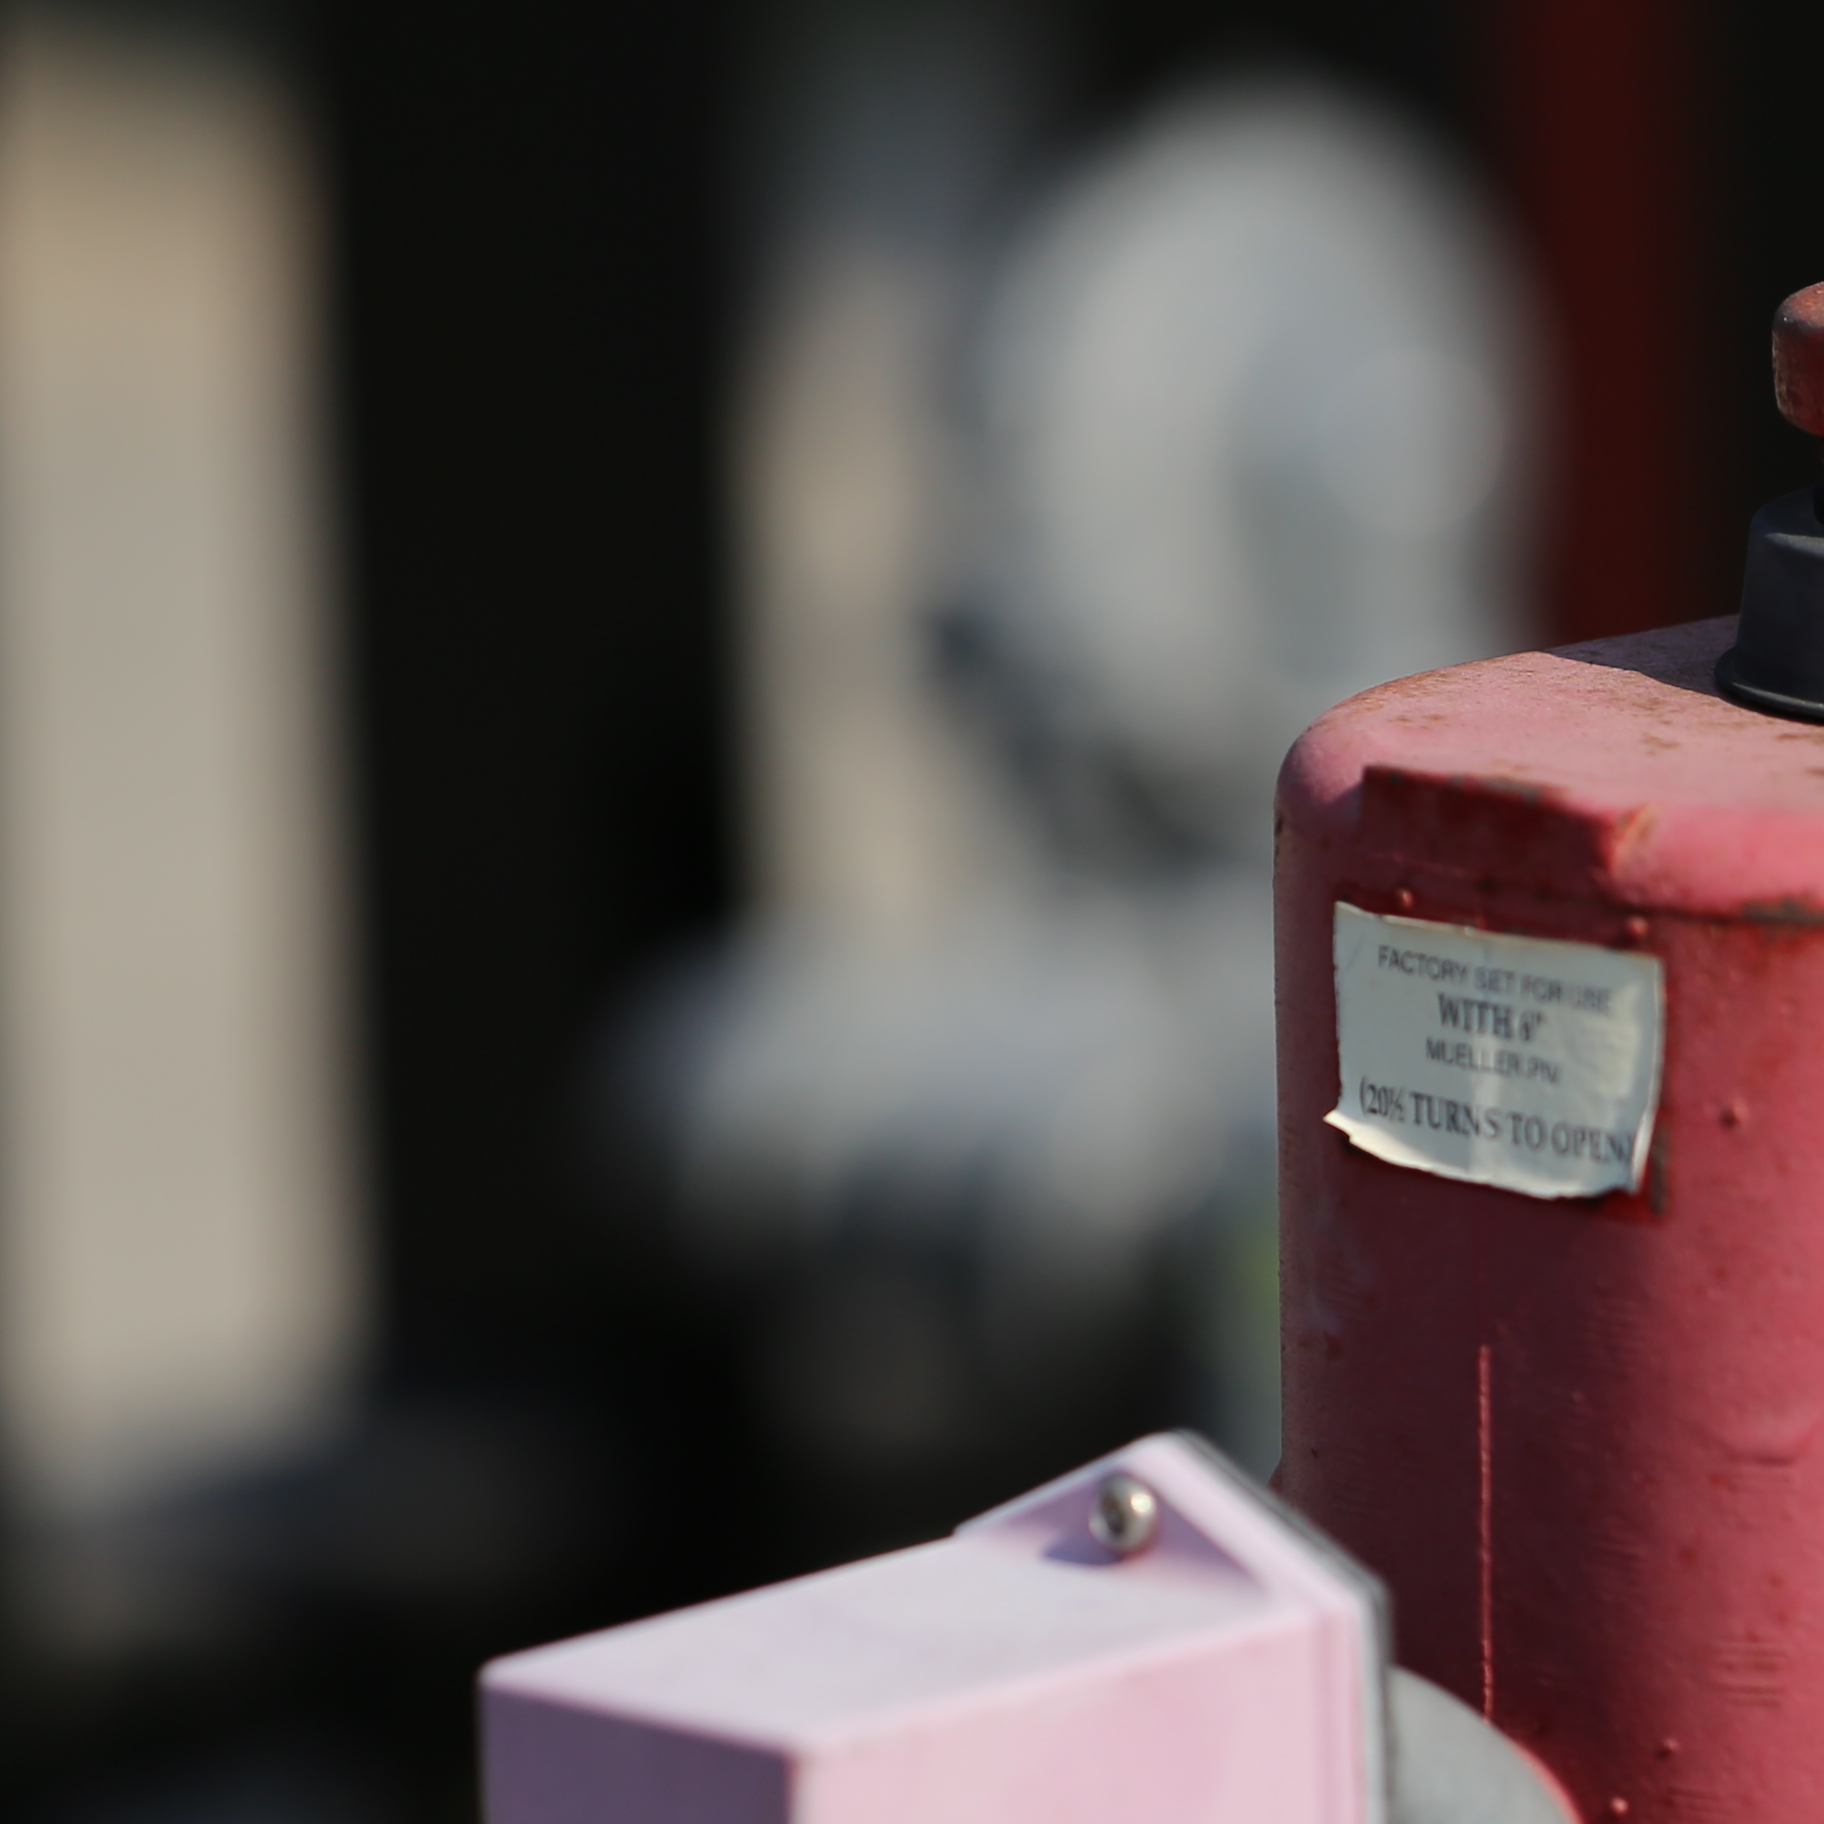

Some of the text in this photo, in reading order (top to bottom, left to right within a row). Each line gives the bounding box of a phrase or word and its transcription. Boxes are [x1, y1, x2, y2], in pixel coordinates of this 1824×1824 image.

[1378, 945, 1468, 983] FACTORY
[1474, 965, 1515, 992] SET
[1520, 973, 1562, 1002] FOR
[1437, 992, 1513, 1040] WITH
[1425, 1035, 1522, 1078] MUELLER
[1409, 1091, 1501, 1139] TURNS
[1506, 1111, 1546, 1151] TO
